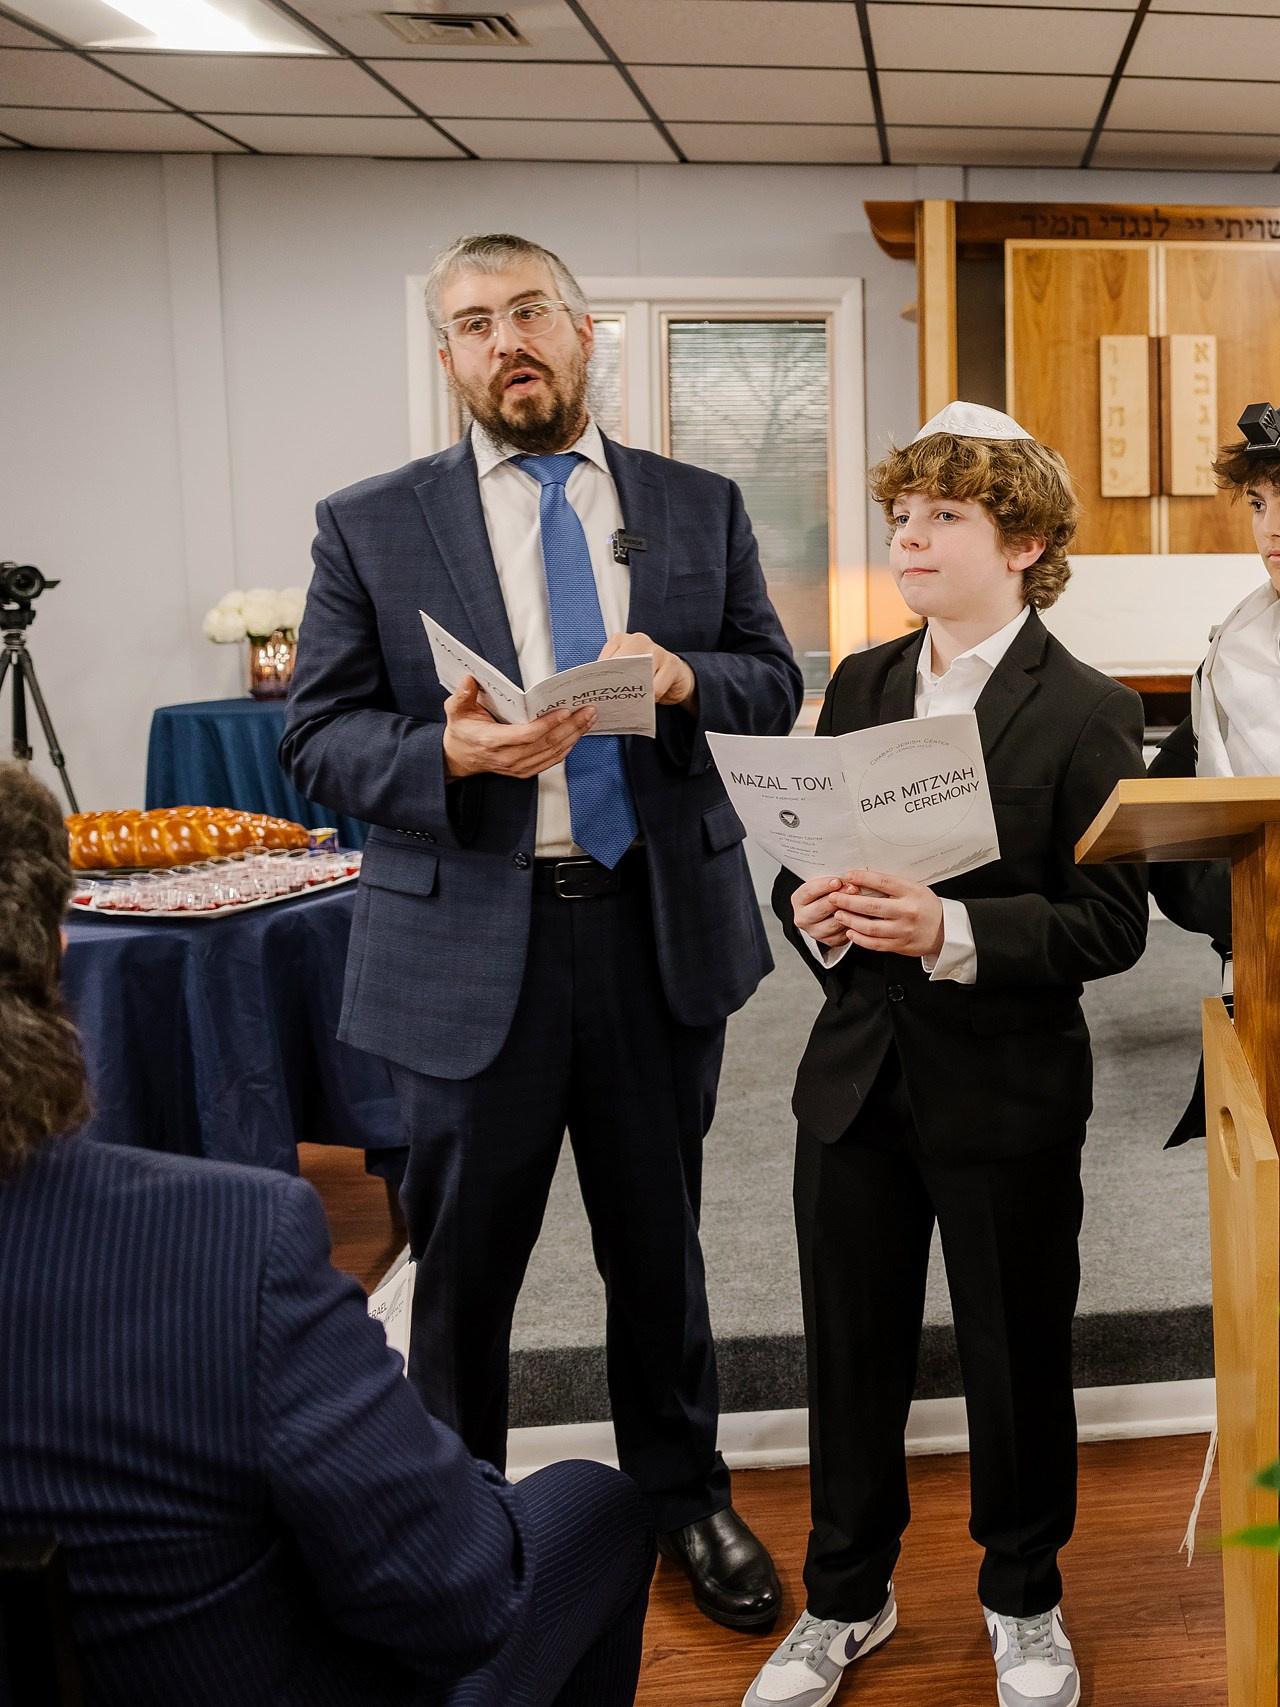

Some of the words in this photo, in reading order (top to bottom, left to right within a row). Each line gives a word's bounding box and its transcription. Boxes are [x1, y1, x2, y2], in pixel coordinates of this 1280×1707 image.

[1020, 212, 1090, 237] תמיד
[1103, 207, 1171, 239] לנגדי
[572, 685, 643, 702] MITZVAH
[572, 692, 647, 707] CEREMONY
[870, 747, 895, 766] CHABAD
[895, 739, 922, 750] JEWISH
[923, 738, 951, 747] CENTER
[730, 771, 788, 791] MAZAL
[791, 776, 834, 792] TOV!
[860, 790, 897, 813] BAR
[901, 767, 975, 799] MITZVAH
[904, 780, 981, 814] CEREMONY
